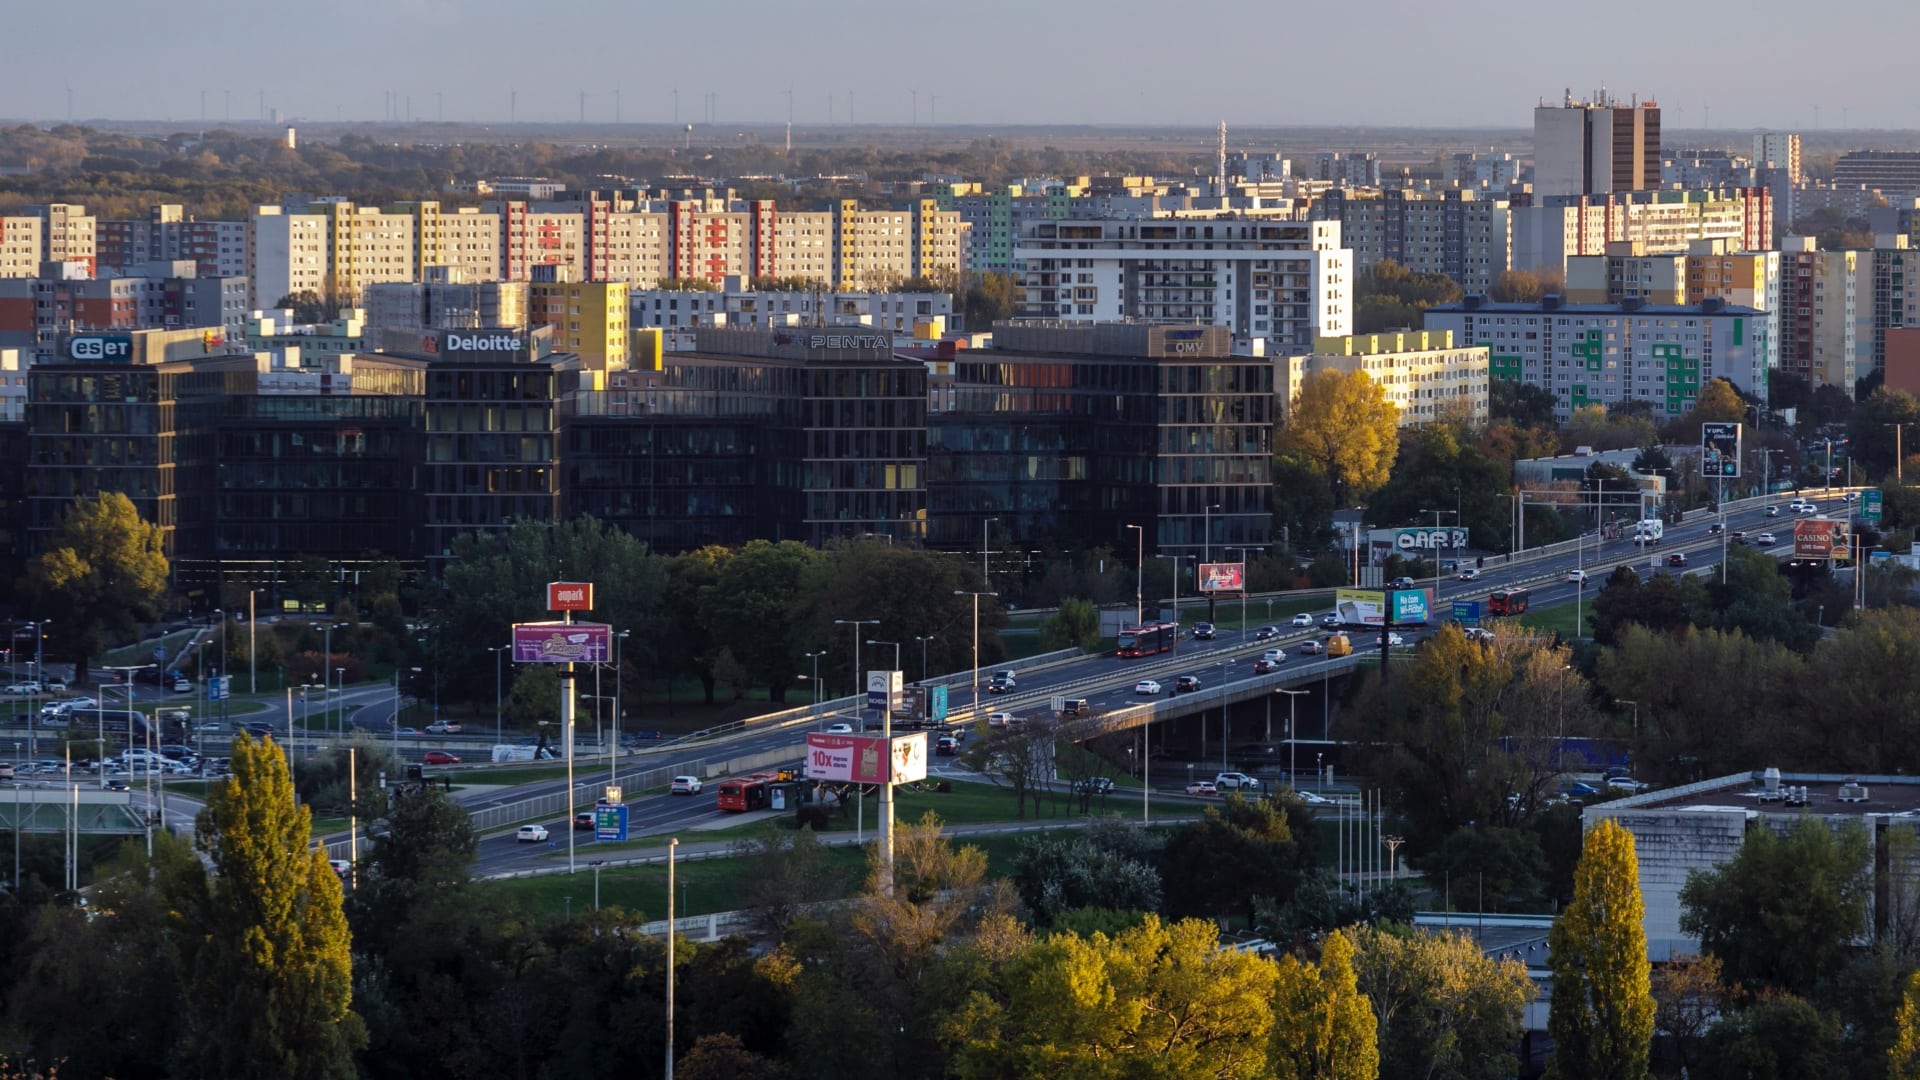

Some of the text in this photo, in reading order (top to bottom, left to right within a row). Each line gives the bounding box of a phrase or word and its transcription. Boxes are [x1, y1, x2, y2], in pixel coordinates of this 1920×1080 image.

[447, 334, 522, 351] Deloitte
[811, 335, 889, 349] PENTA
[1175, 342, 1204, 353] OMV
[1797, 534, 1829, 542] CASINO
[557, 588, 584, 603] aupark
[812, 751, 832, 767] 10x
